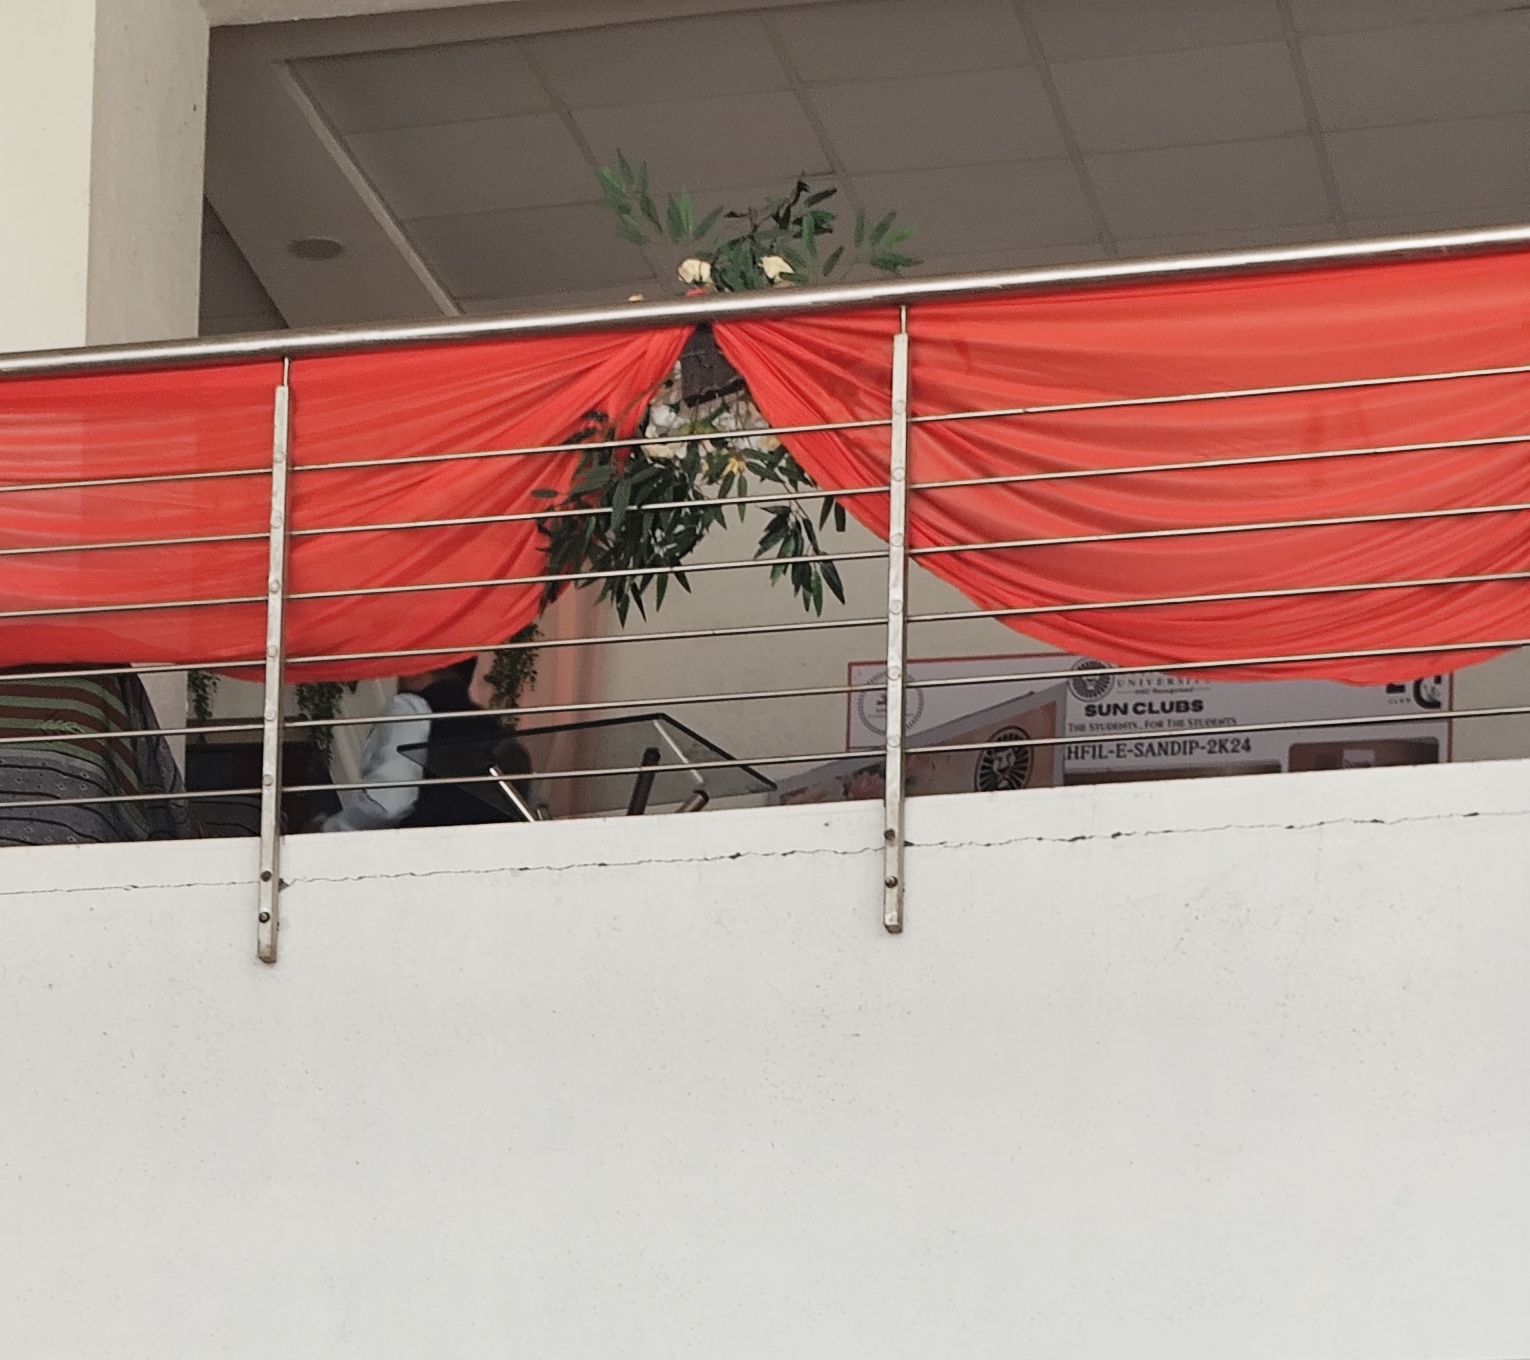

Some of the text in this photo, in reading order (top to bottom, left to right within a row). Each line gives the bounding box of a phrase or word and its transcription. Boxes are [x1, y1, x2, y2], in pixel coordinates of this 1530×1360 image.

[1084, 699, 1204, 717] SUN CLUBS
[1064, 737, 1252, 761] HFIL-E-SANDIP-2K24
